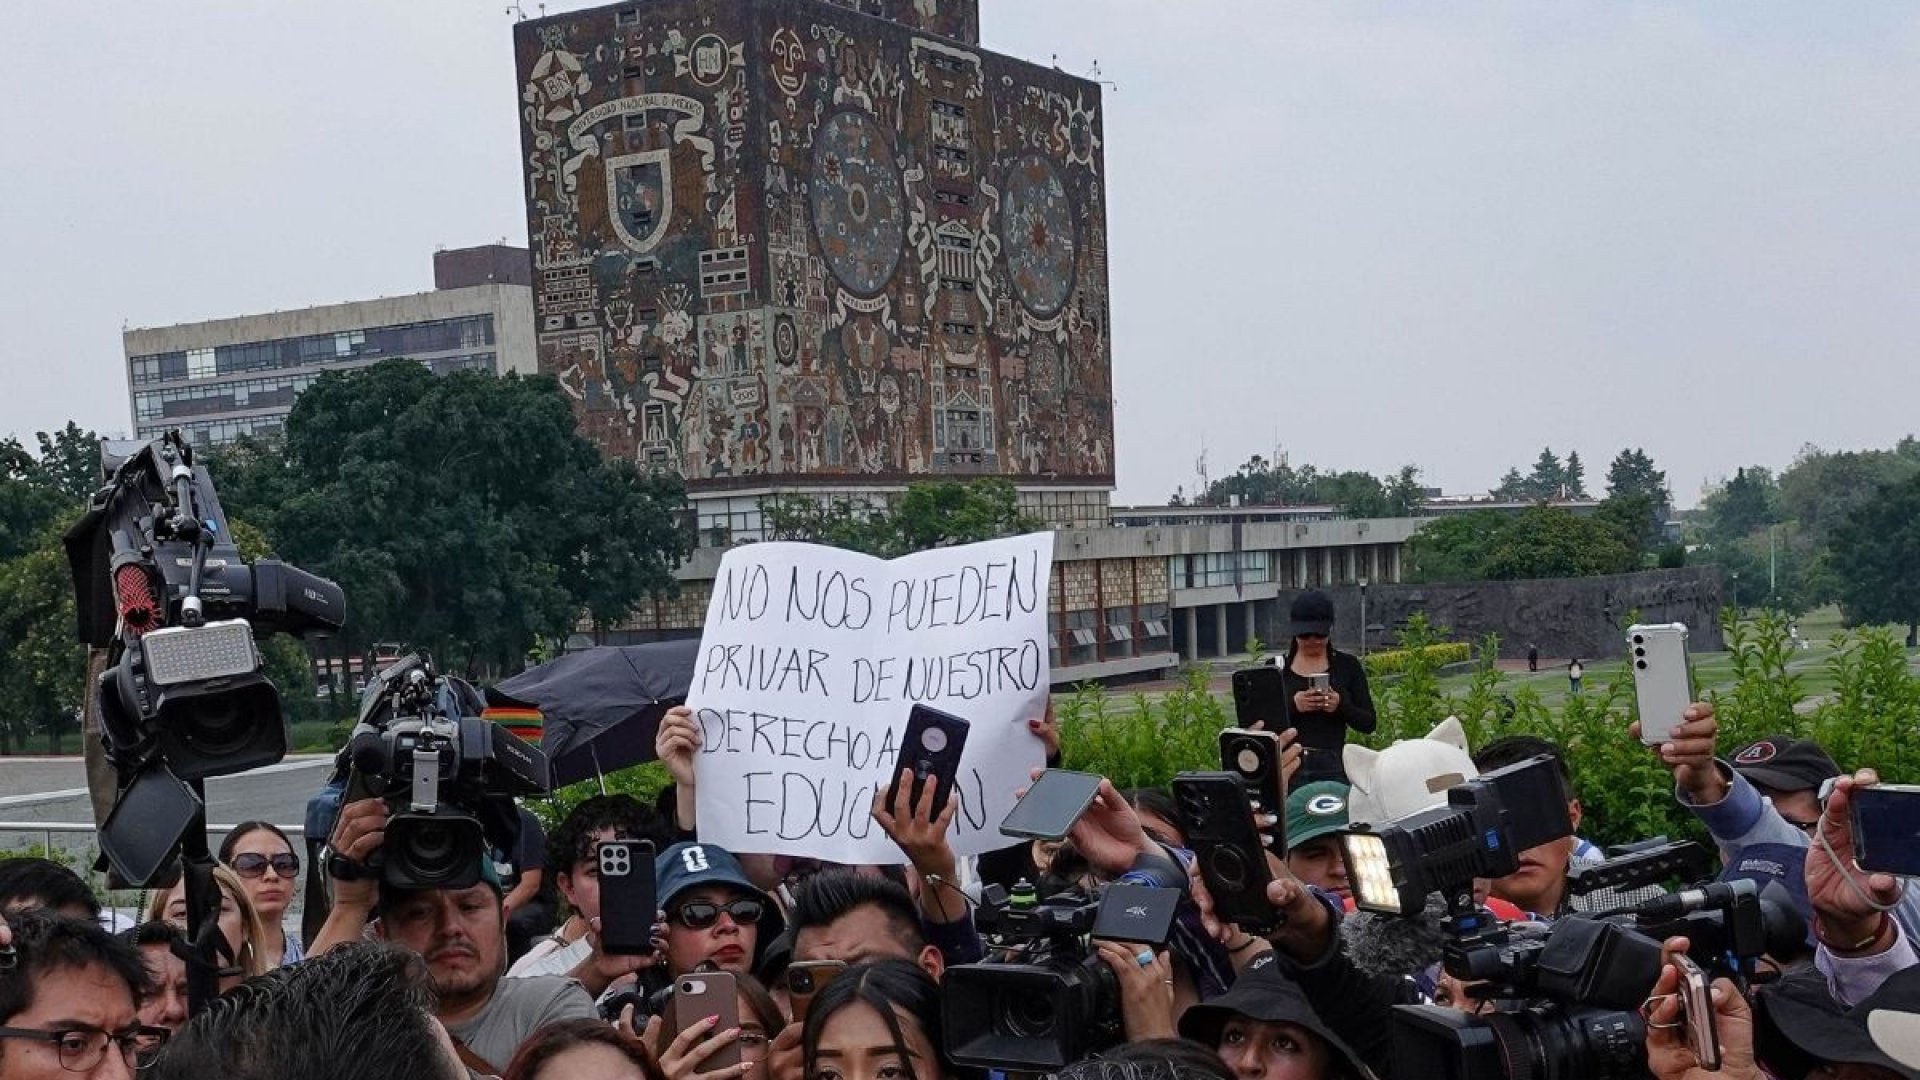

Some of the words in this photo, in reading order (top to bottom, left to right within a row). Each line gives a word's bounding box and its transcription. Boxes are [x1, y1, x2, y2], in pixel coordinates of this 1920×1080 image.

[720, 564, 769, 625] NO
[786, 565, 872, 630] NOS
[886, 549, 1038, 634] PUEDEN
[702, 644, 830, 697] PRIVAR
[852, 657, 897, 704] DE
[902, 639, 1041, 702] NUESTRO
[697, 707, 871, 770] DERECHO
[742, 767, 987, 841] EDUCN
